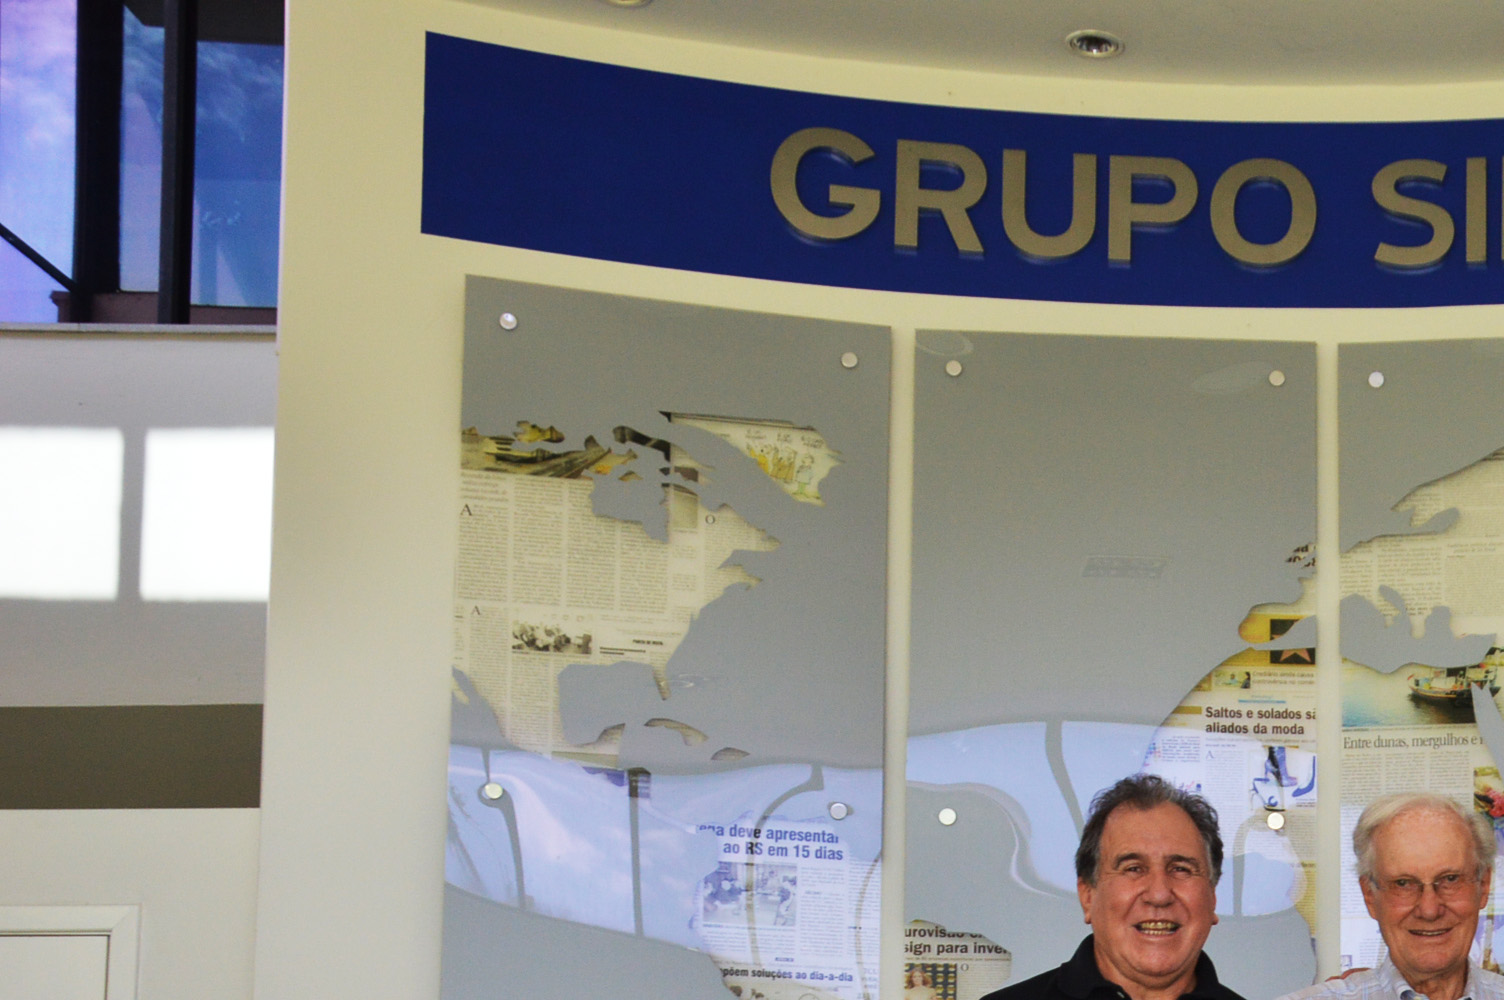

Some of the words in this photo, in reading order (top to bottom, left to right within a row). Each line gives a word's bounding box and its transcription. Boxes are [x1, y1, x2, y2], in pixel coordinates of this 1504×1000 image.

[770, 127, 1317, 268] GRUPO
[1205, 706, 1242, 719] Saltos
[1246, 709, 1254, 719] e
[1257, 708, 1302, 720] solados
[1205, 722, 1249, 734] aliados
[1253, 723, 1267, 734] da
[1271, 723, 1305, 735] moda
[1343, 736, 1371, 749] Entre
[1373, 735, 1409, 749] dunas,
[1411, 732, 1469, 750] mergulhos
[729, 823, 762, 839] deve
[723, 843, 740, 853] ao
[745, 842, 763, 855] RS
[768, 846, 788, 857] em
[793, 844, 810, 858] 15
[815, 847, 844, 861] dias
[937, 943, 969, 956] para
[720, 967, 749, 978] põem
[751, 969, 793, 981] soluções
[795, 971, 807, 980] ao
[809, 970, 853, 982] dia-a-dia
